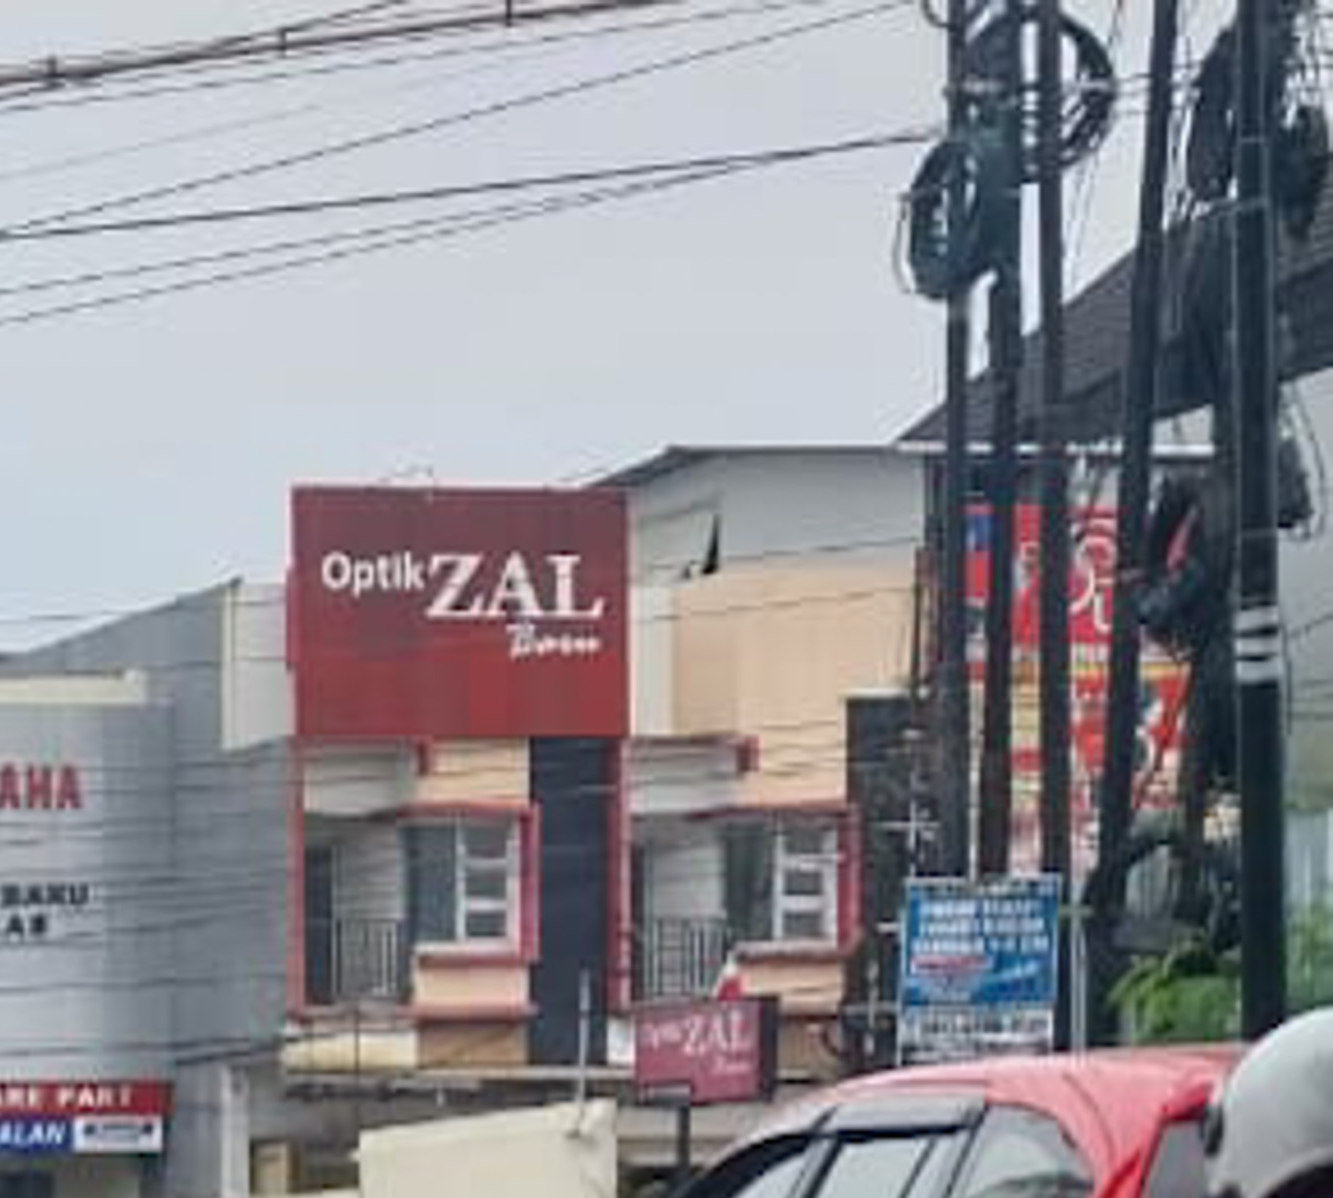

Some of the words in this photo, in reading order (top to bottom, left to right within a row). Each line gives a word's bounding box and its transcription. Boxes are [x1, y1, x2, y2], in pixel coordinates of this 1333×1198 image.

[322, 551, 424, 595] Optik
[425, 553, 605, 619] ZAL
[683, 1009, 751, 1055] ZAL
